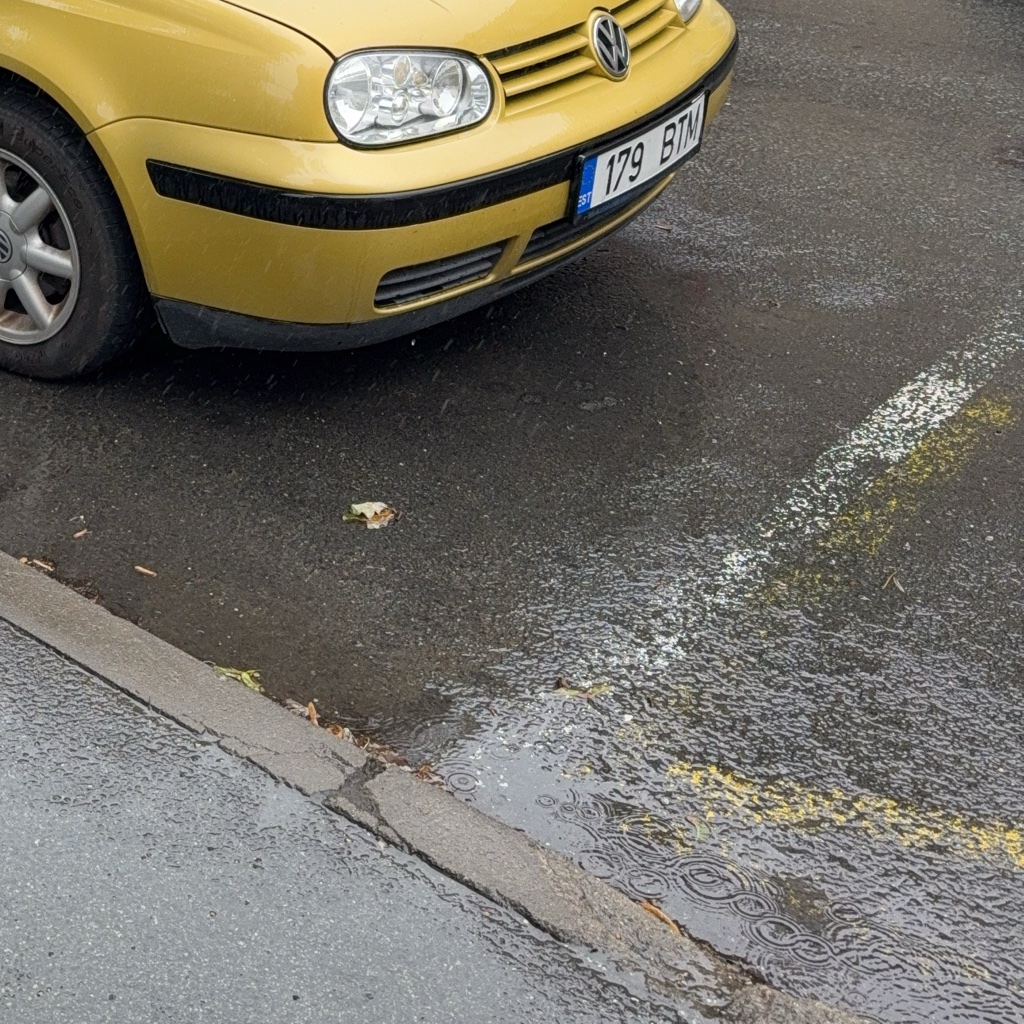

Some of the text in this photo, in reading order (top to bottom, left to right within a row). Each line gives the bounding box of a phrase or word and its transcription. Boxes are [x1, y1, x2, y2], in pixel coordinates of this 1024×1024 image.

[605, 102, 701, 197] 179 BTM
[577, 191, 592, 208] EST
